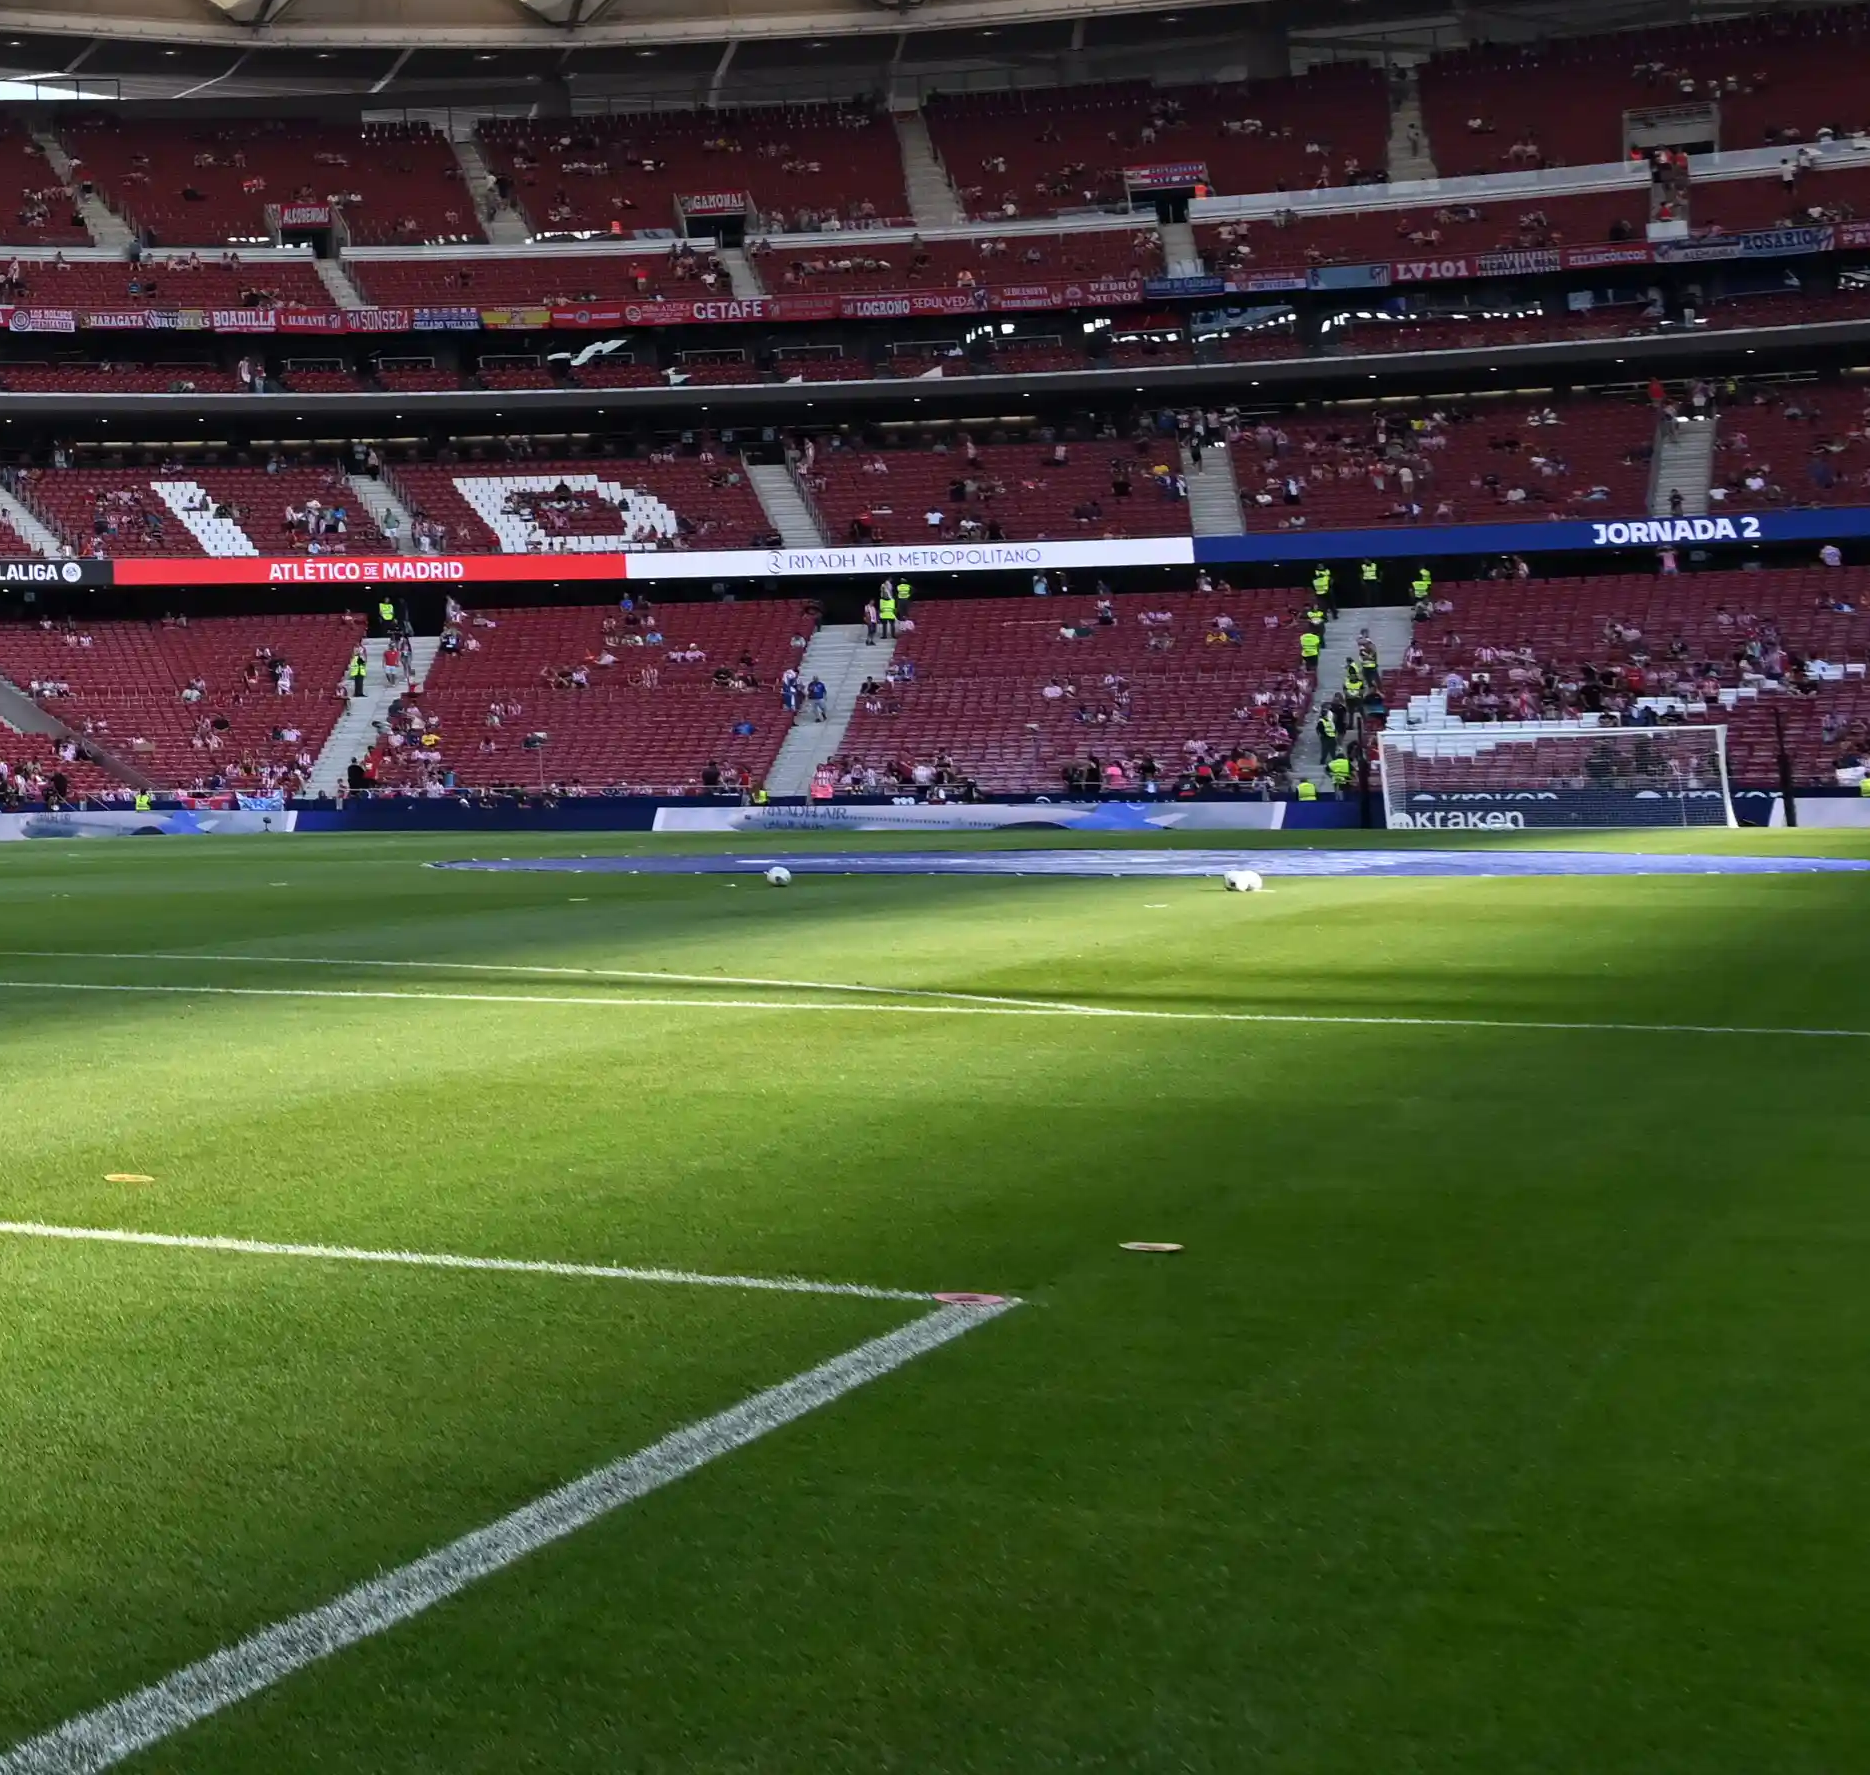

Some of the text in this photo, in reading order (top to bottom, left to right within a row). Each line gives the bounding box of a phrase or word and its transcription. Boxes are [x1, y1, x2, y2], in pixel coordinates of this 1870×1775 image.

[1743, 228, 1813, 251] ROSARIO
[1395, 259, 1469, 280] LV101
[1088, 279, 1137, 292] PEDRO
[212, 310, 276, 327] BOADILLA
[360, 310, 410, 330] SONSECA
[692, 300, 764, 320] GETAFE
[1591, 516, 1762, 545] JORNADA 2
[788, 547, 1041, 569] RIYADH AIR METROPOLITANO
[269, 559, 360, 580] ATLÉTICO
[383, 562, 464, 580] MADRID
[1414, 808, 1525, 829] kraken
